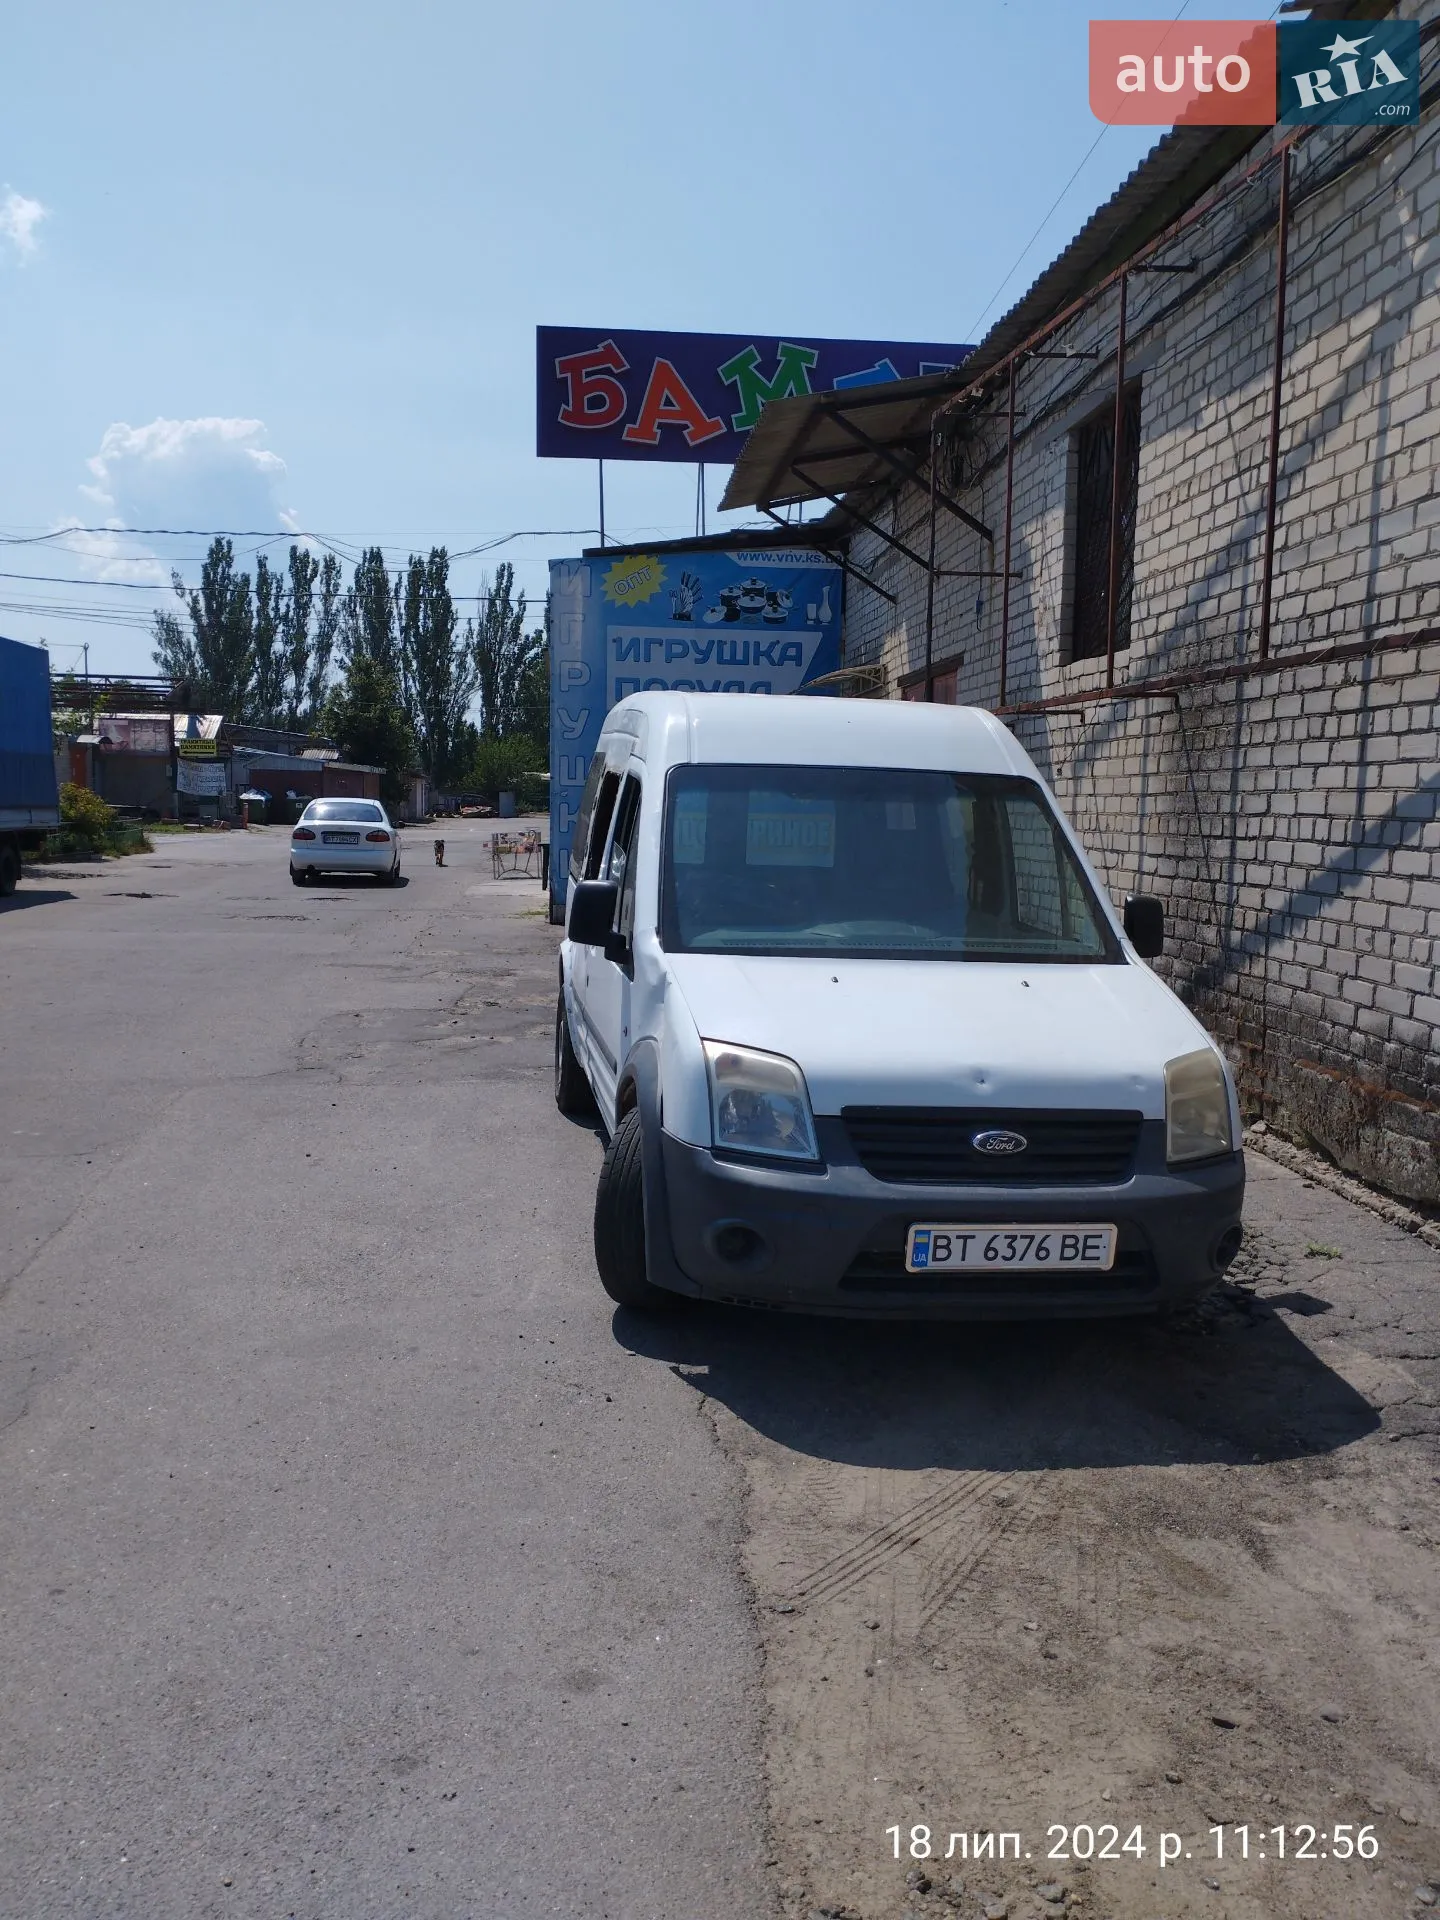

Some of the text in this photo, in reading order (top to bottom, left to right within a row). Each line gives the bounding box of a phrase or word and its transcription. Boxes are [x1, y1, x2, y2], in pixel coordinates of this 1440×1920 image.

[614, 565, 651, 595] ОПТ
[615, 637, 803, 666] ИГРУШКА
[986, 1137, 1016, 1150] Ford
[913, 1253, 927, 1263] UA
[931, 1234, 1103, 1262] BT 6376 BE
